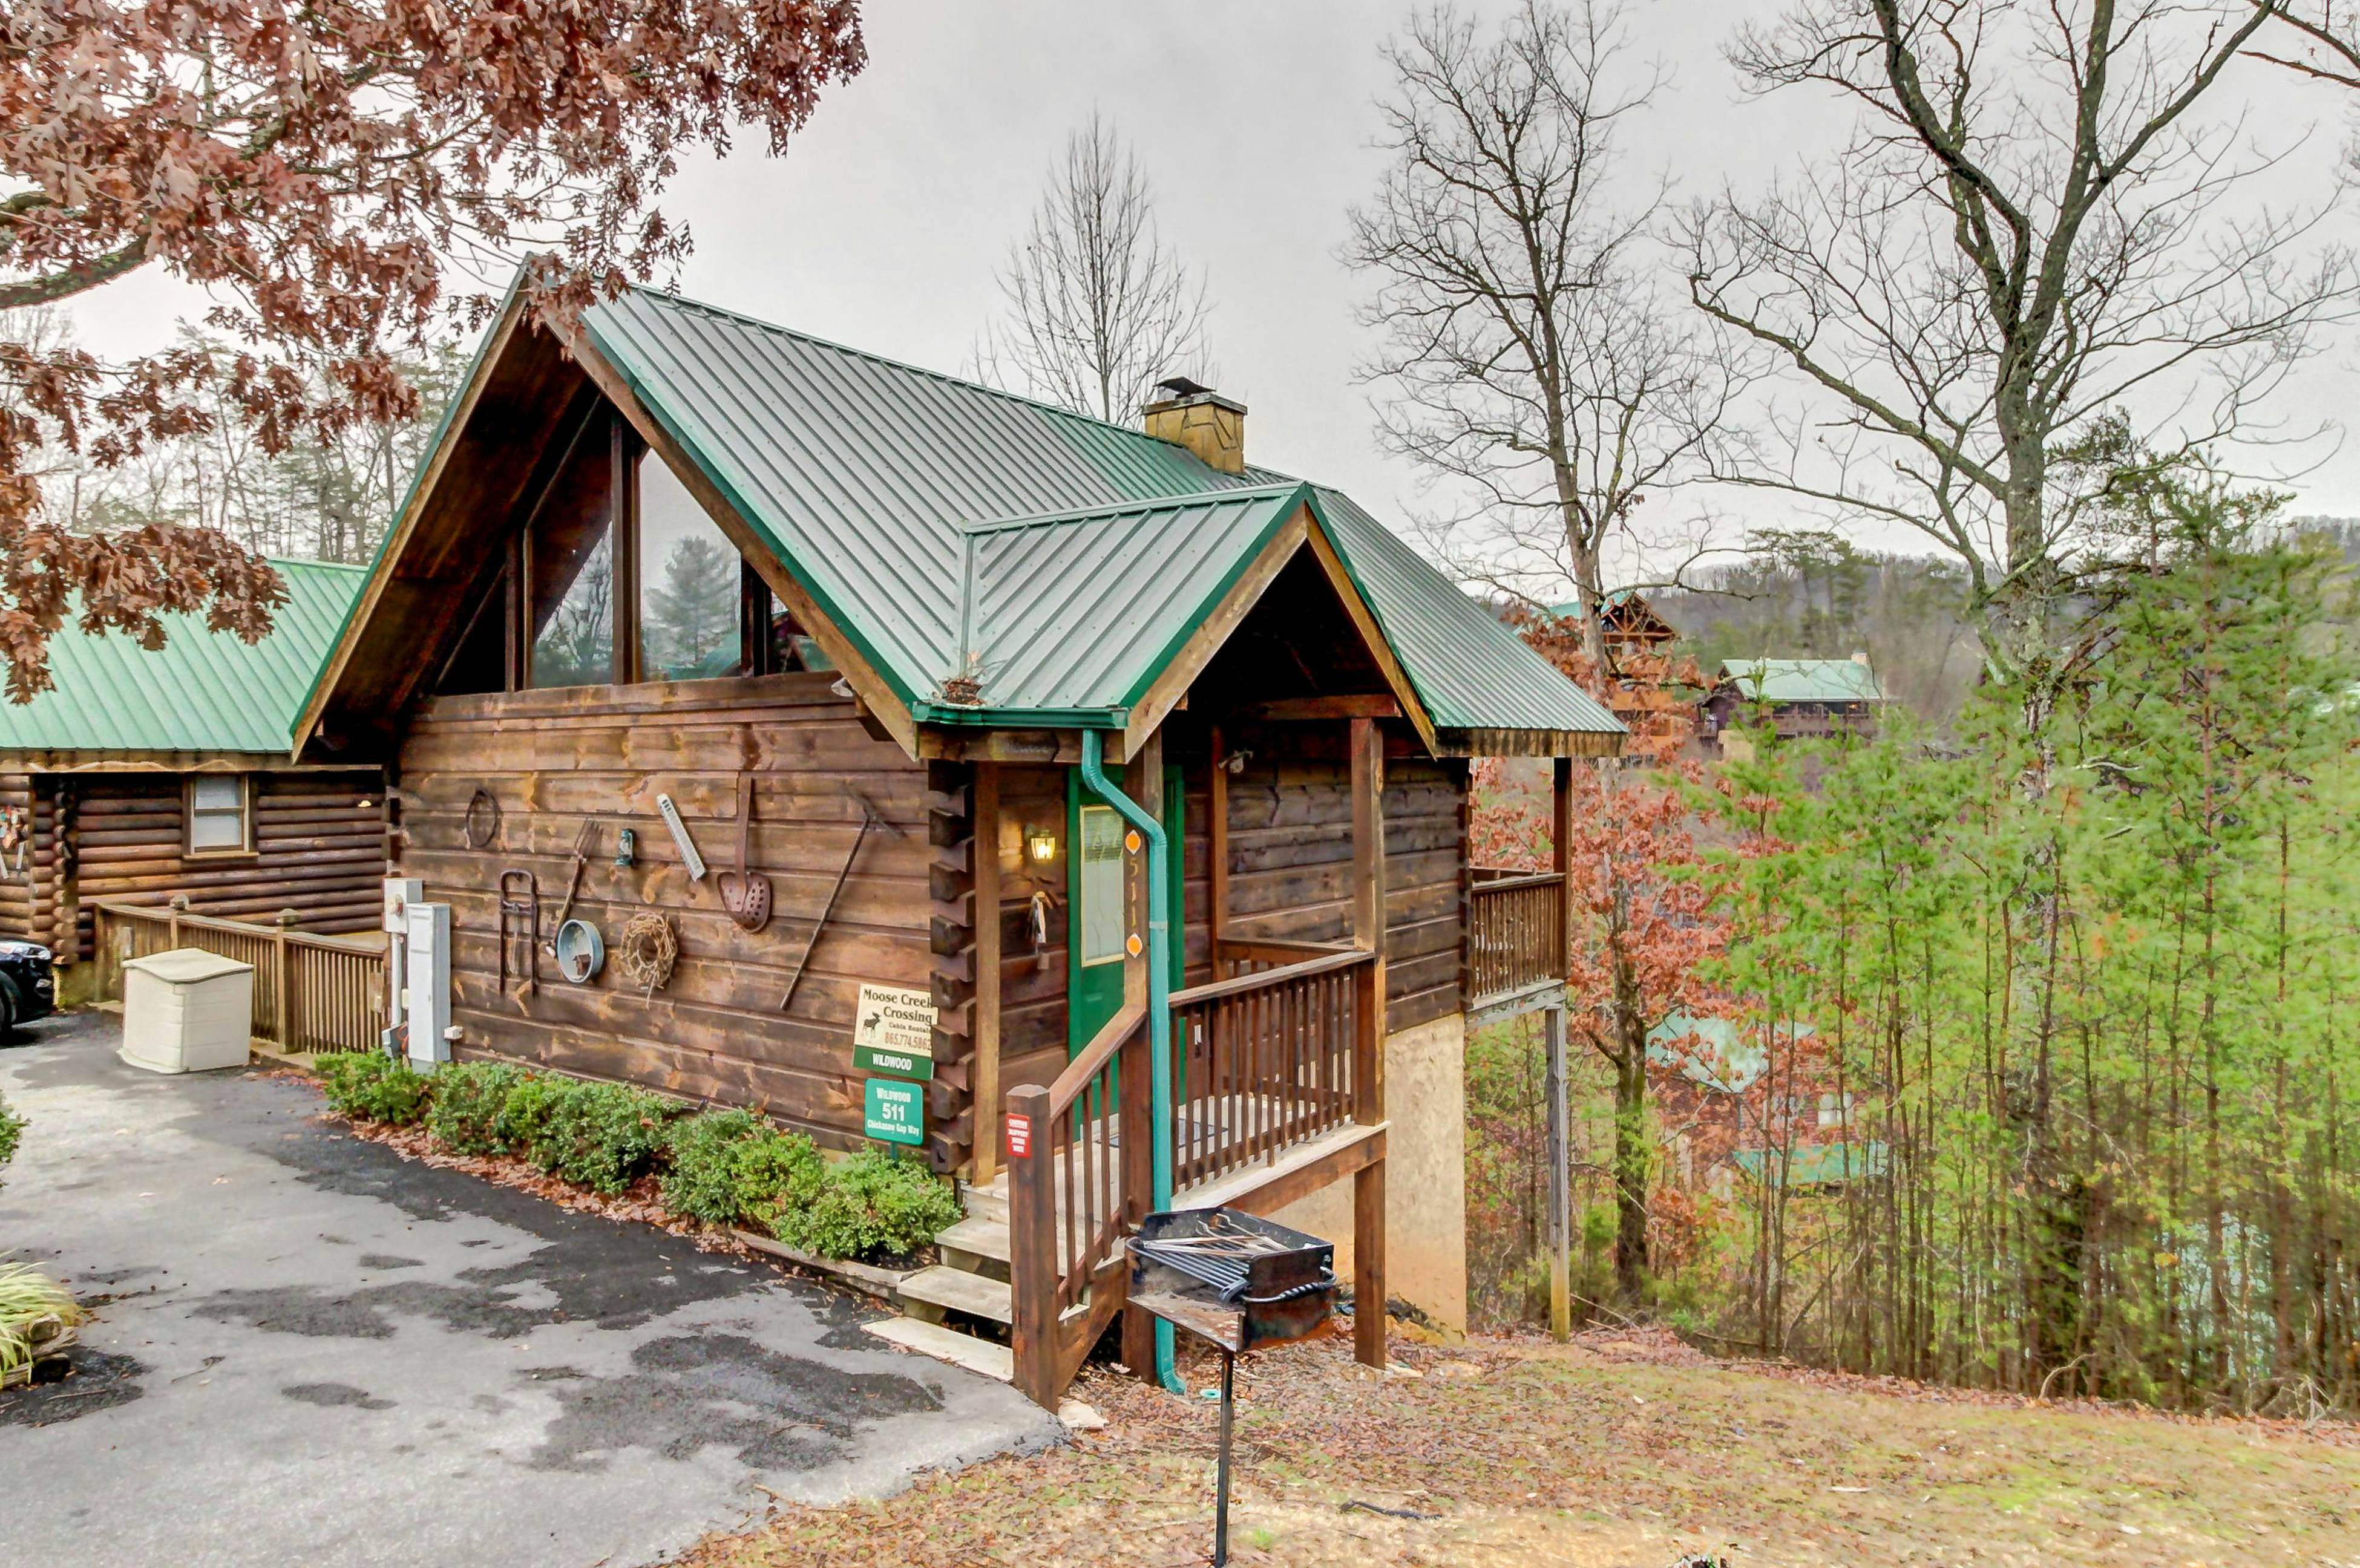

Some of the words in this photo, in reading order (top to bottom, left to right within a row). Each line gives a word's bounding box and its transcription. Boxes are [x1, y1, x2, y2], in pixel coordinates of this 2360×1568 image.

[864, 988, 897, 1004] Moose
[883, 1006, 933, 1026] Crossing
[873, 1053, 913, 1071] WILDWOOD
[882, 1102, 905, 1122] 511
[907, 1125, 920, 1137] Way
